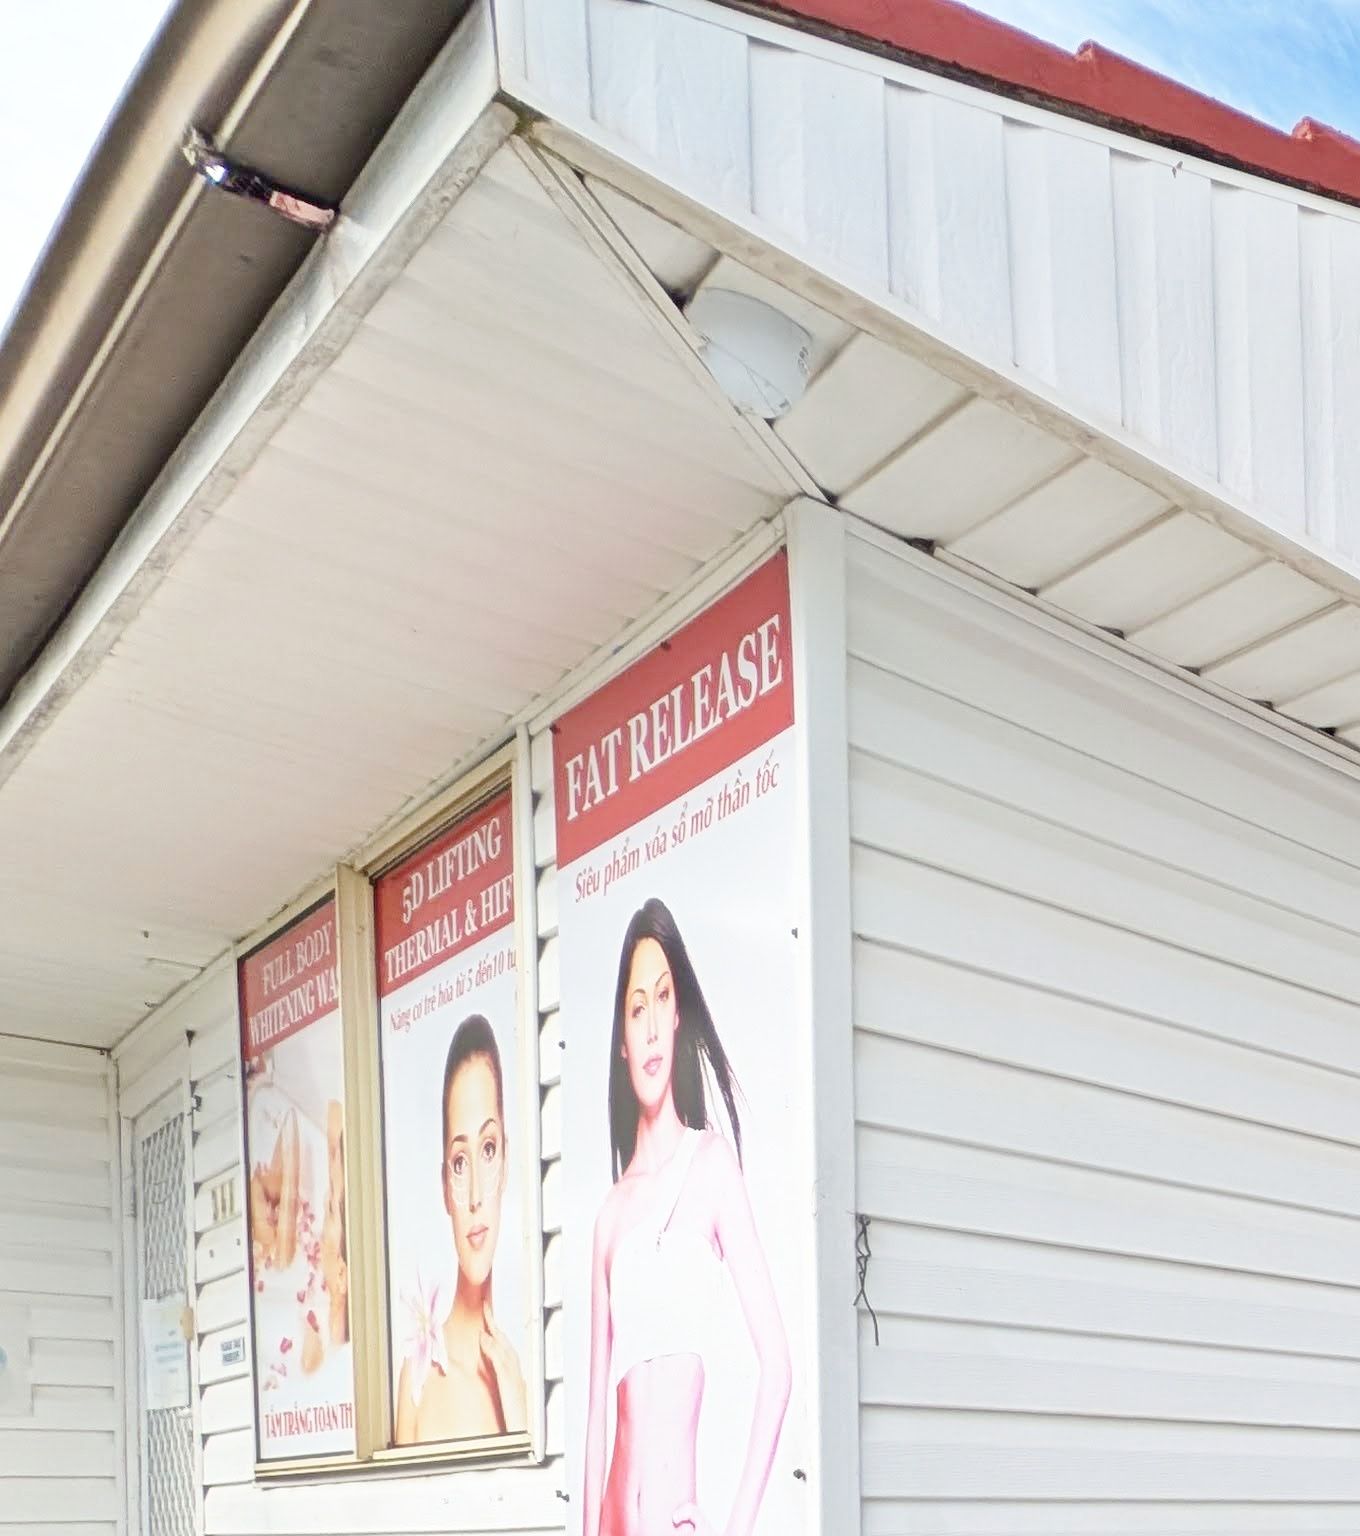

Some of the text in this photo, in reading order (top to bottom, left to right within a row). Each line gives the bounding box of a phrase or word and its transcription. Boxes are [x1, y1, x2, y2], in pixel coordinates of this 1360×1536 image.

[566, 614, 783, 822] FAT RELEASE
[402, 817, 502, 924] 5D LIFTING
[575, 866, 600, 902] Siêu
[262, 920, 333, 996] FULL BODY
[385, 908, 462, 983] THERMAL
[464, 899, 477, 936] &
[249, 966, 341, 1046] WHITENING WA
